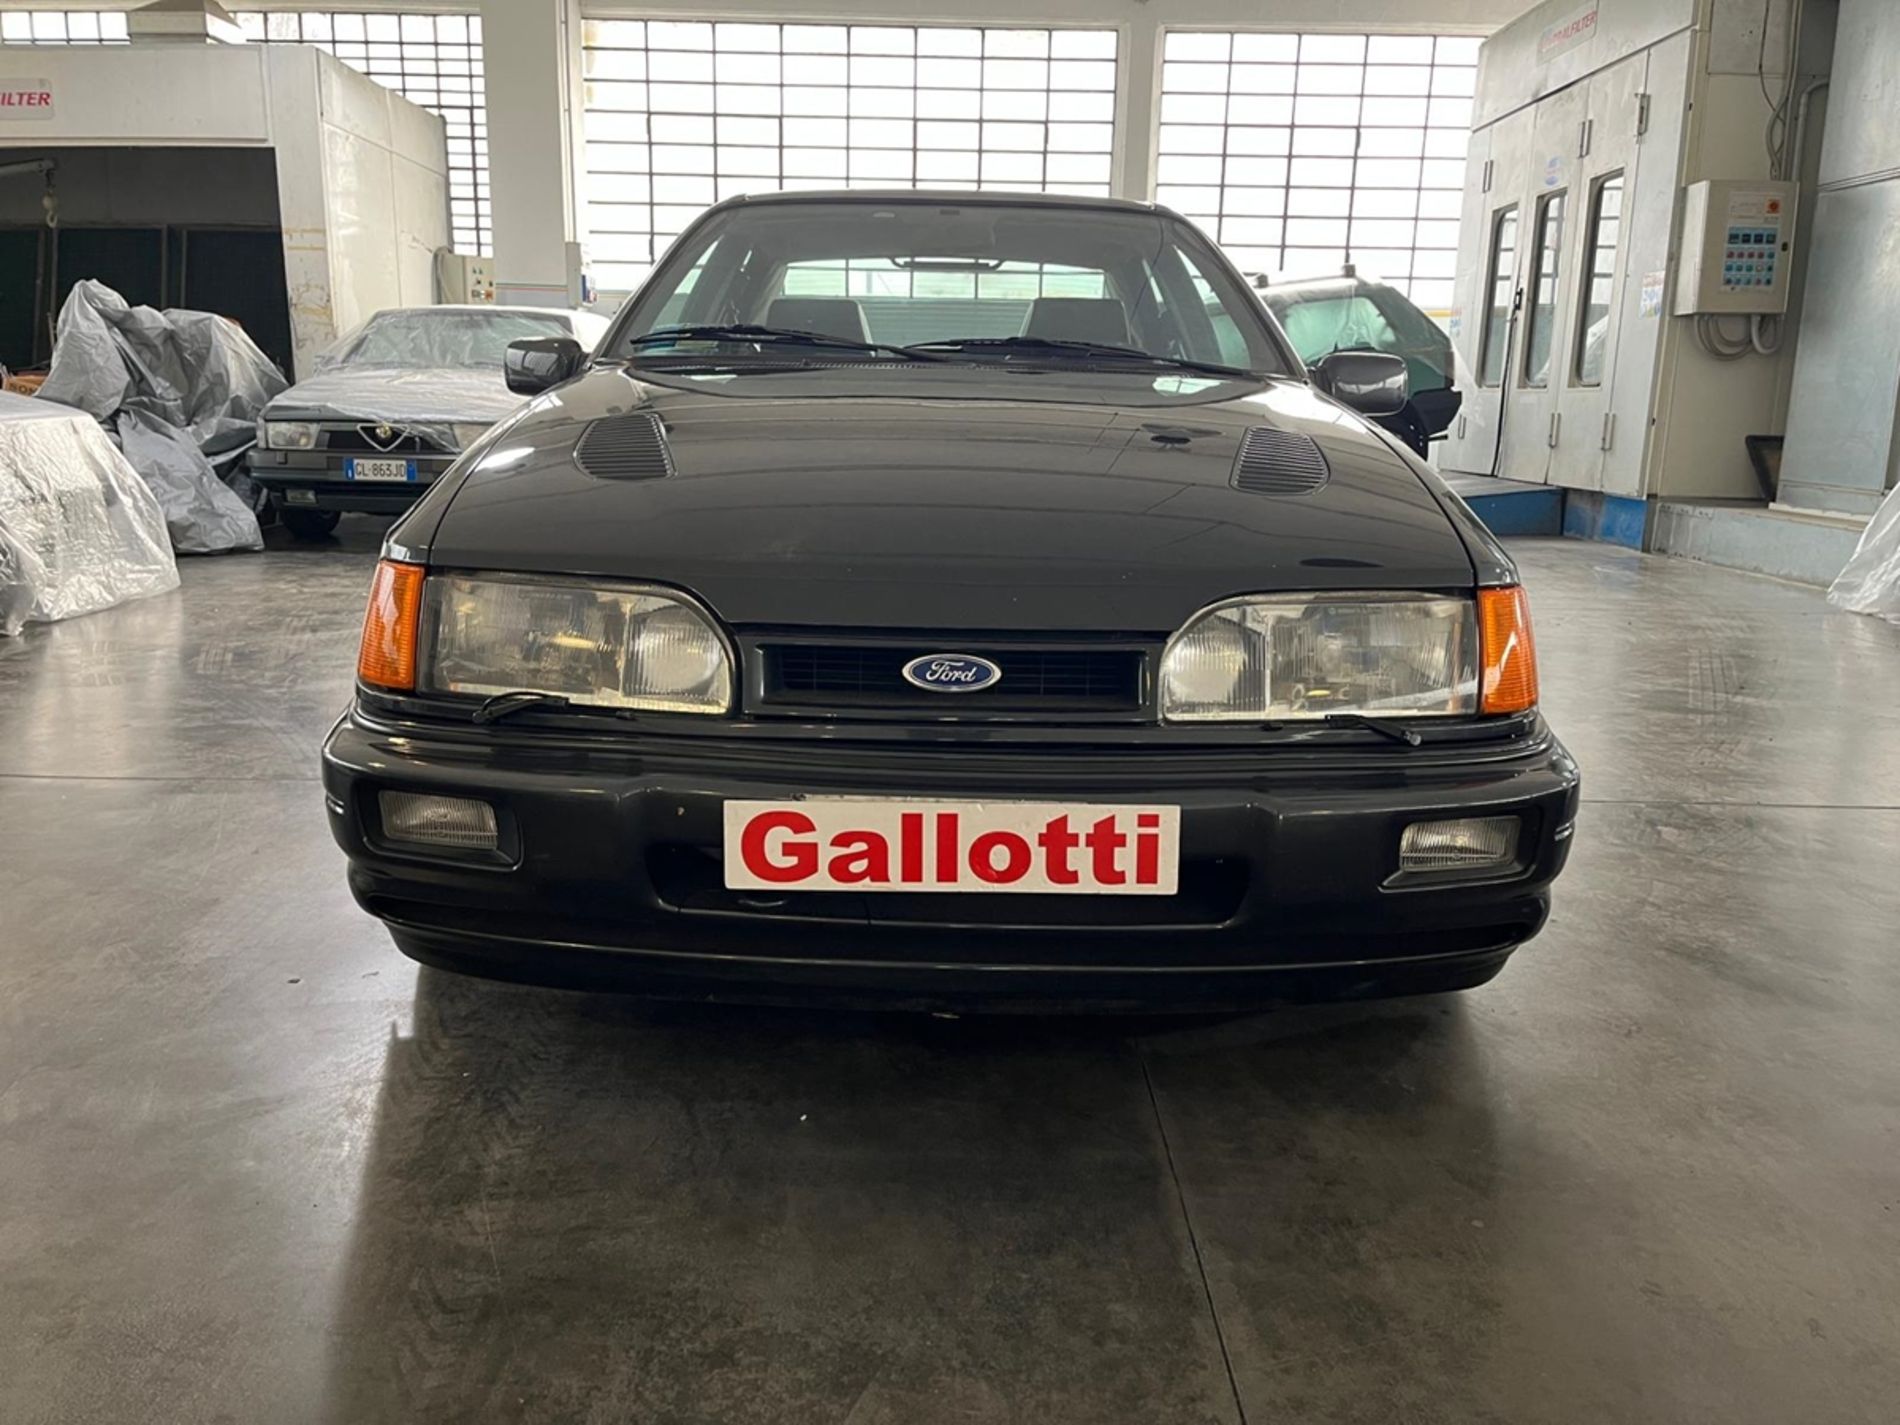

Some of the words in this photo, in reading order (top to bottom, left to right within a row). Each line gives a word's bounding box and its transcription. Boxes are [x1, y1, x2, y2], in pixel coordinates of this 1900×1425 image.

[0, 91, 51, 107] ILTER
[925, 659, 978, 682] Ford
[741, 810, 1160, 884] Gallotti
